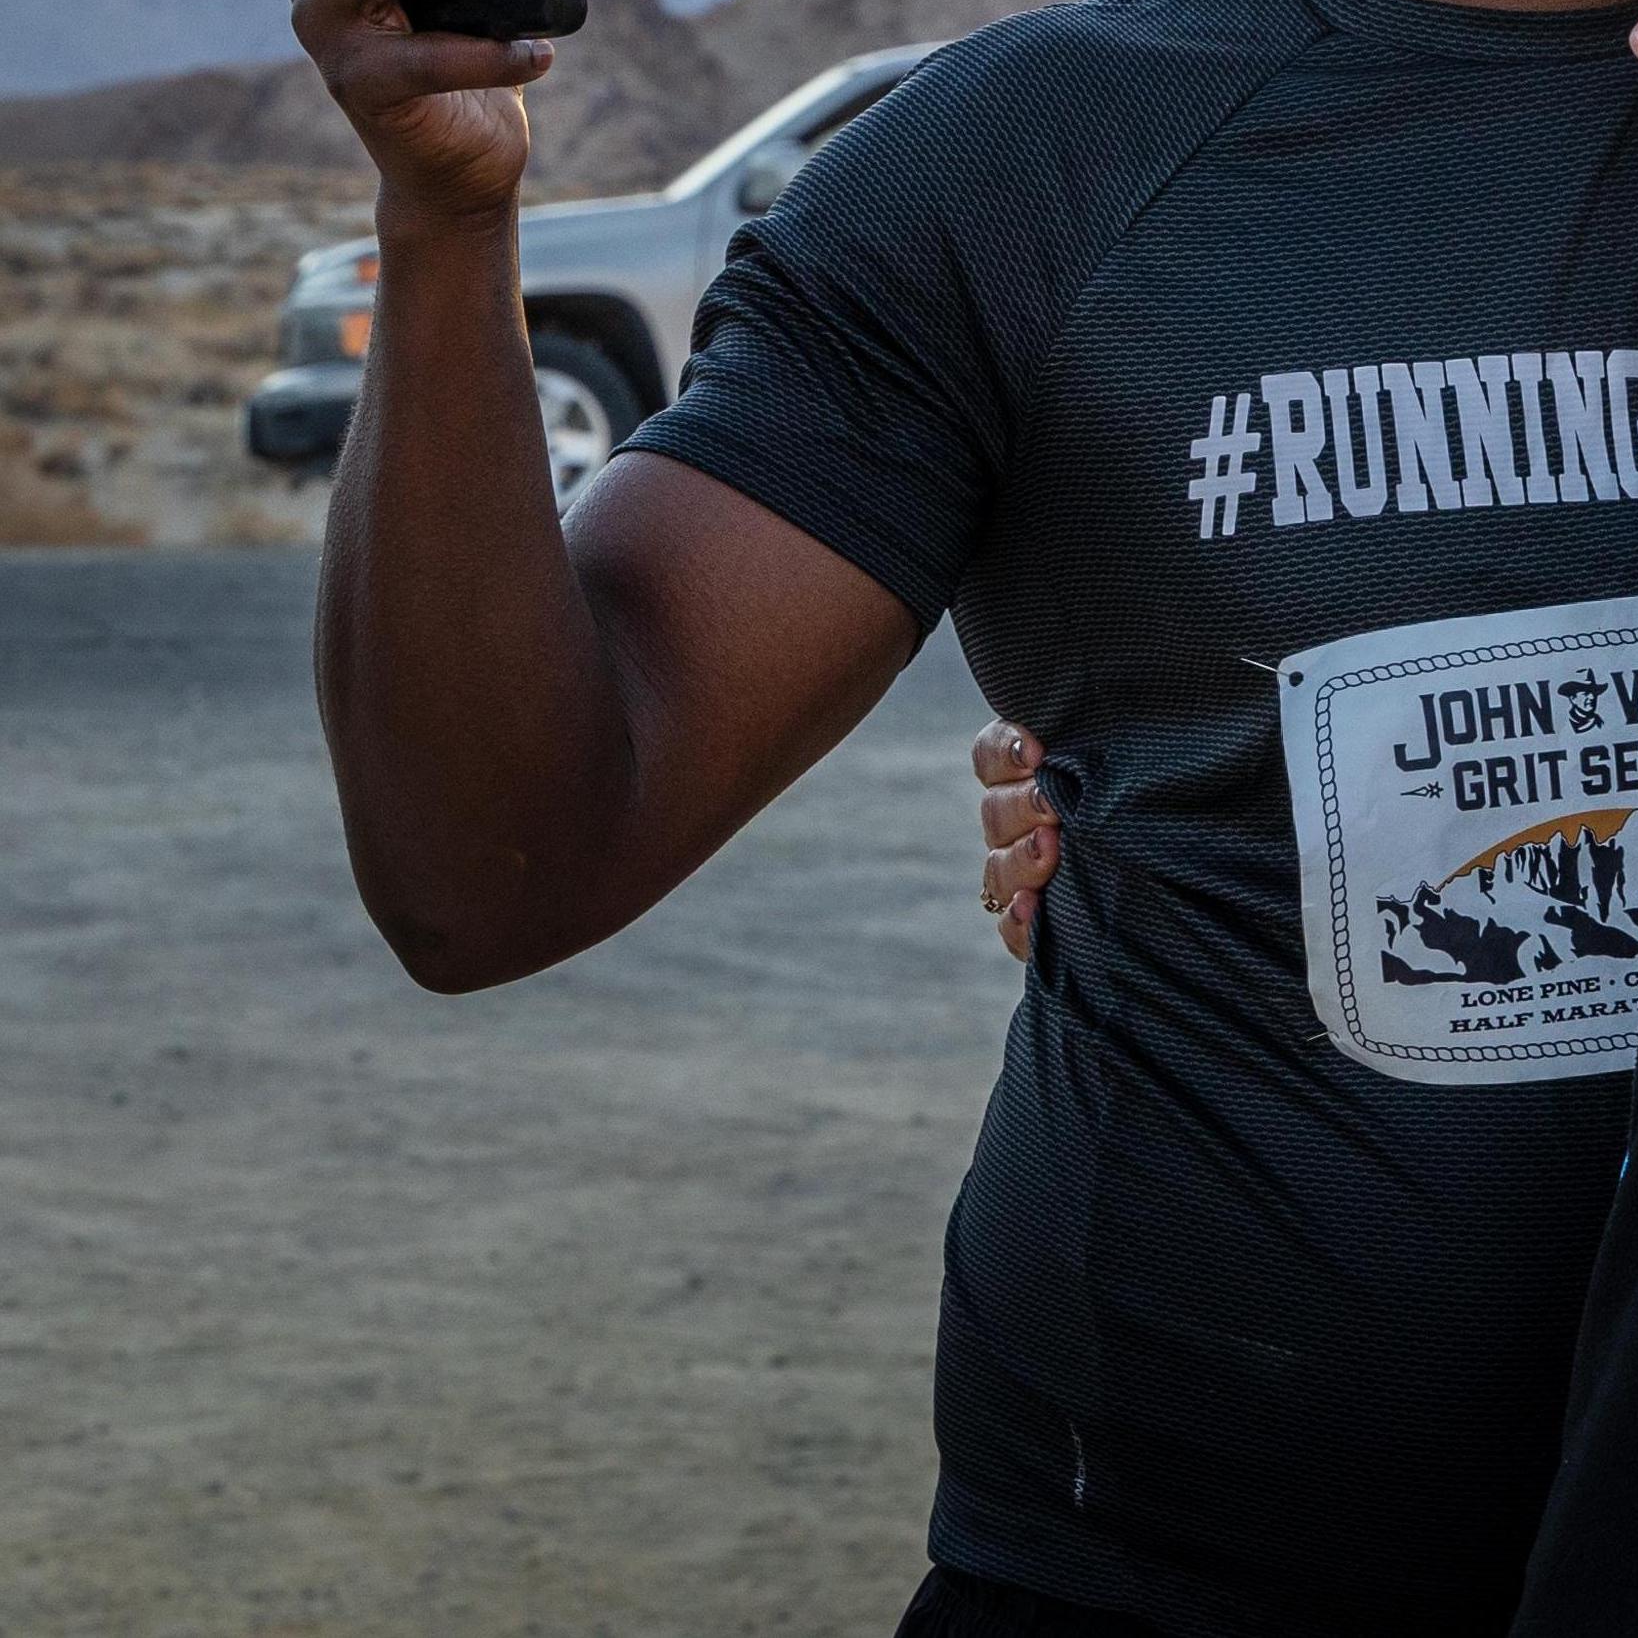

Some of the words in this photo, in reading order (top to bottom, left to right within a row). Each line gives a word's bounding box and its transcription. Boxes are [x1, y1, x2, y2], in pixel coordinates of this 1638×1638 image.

[1393, 681, 1556, 771] JOHN
[1453, 750, 1568, 812] GRIT
[1461, 985, 1534, 1008] LONE
[1540, 976, 1600, 999] PINE
[1450, 1012, 1534, 1033] HALF
